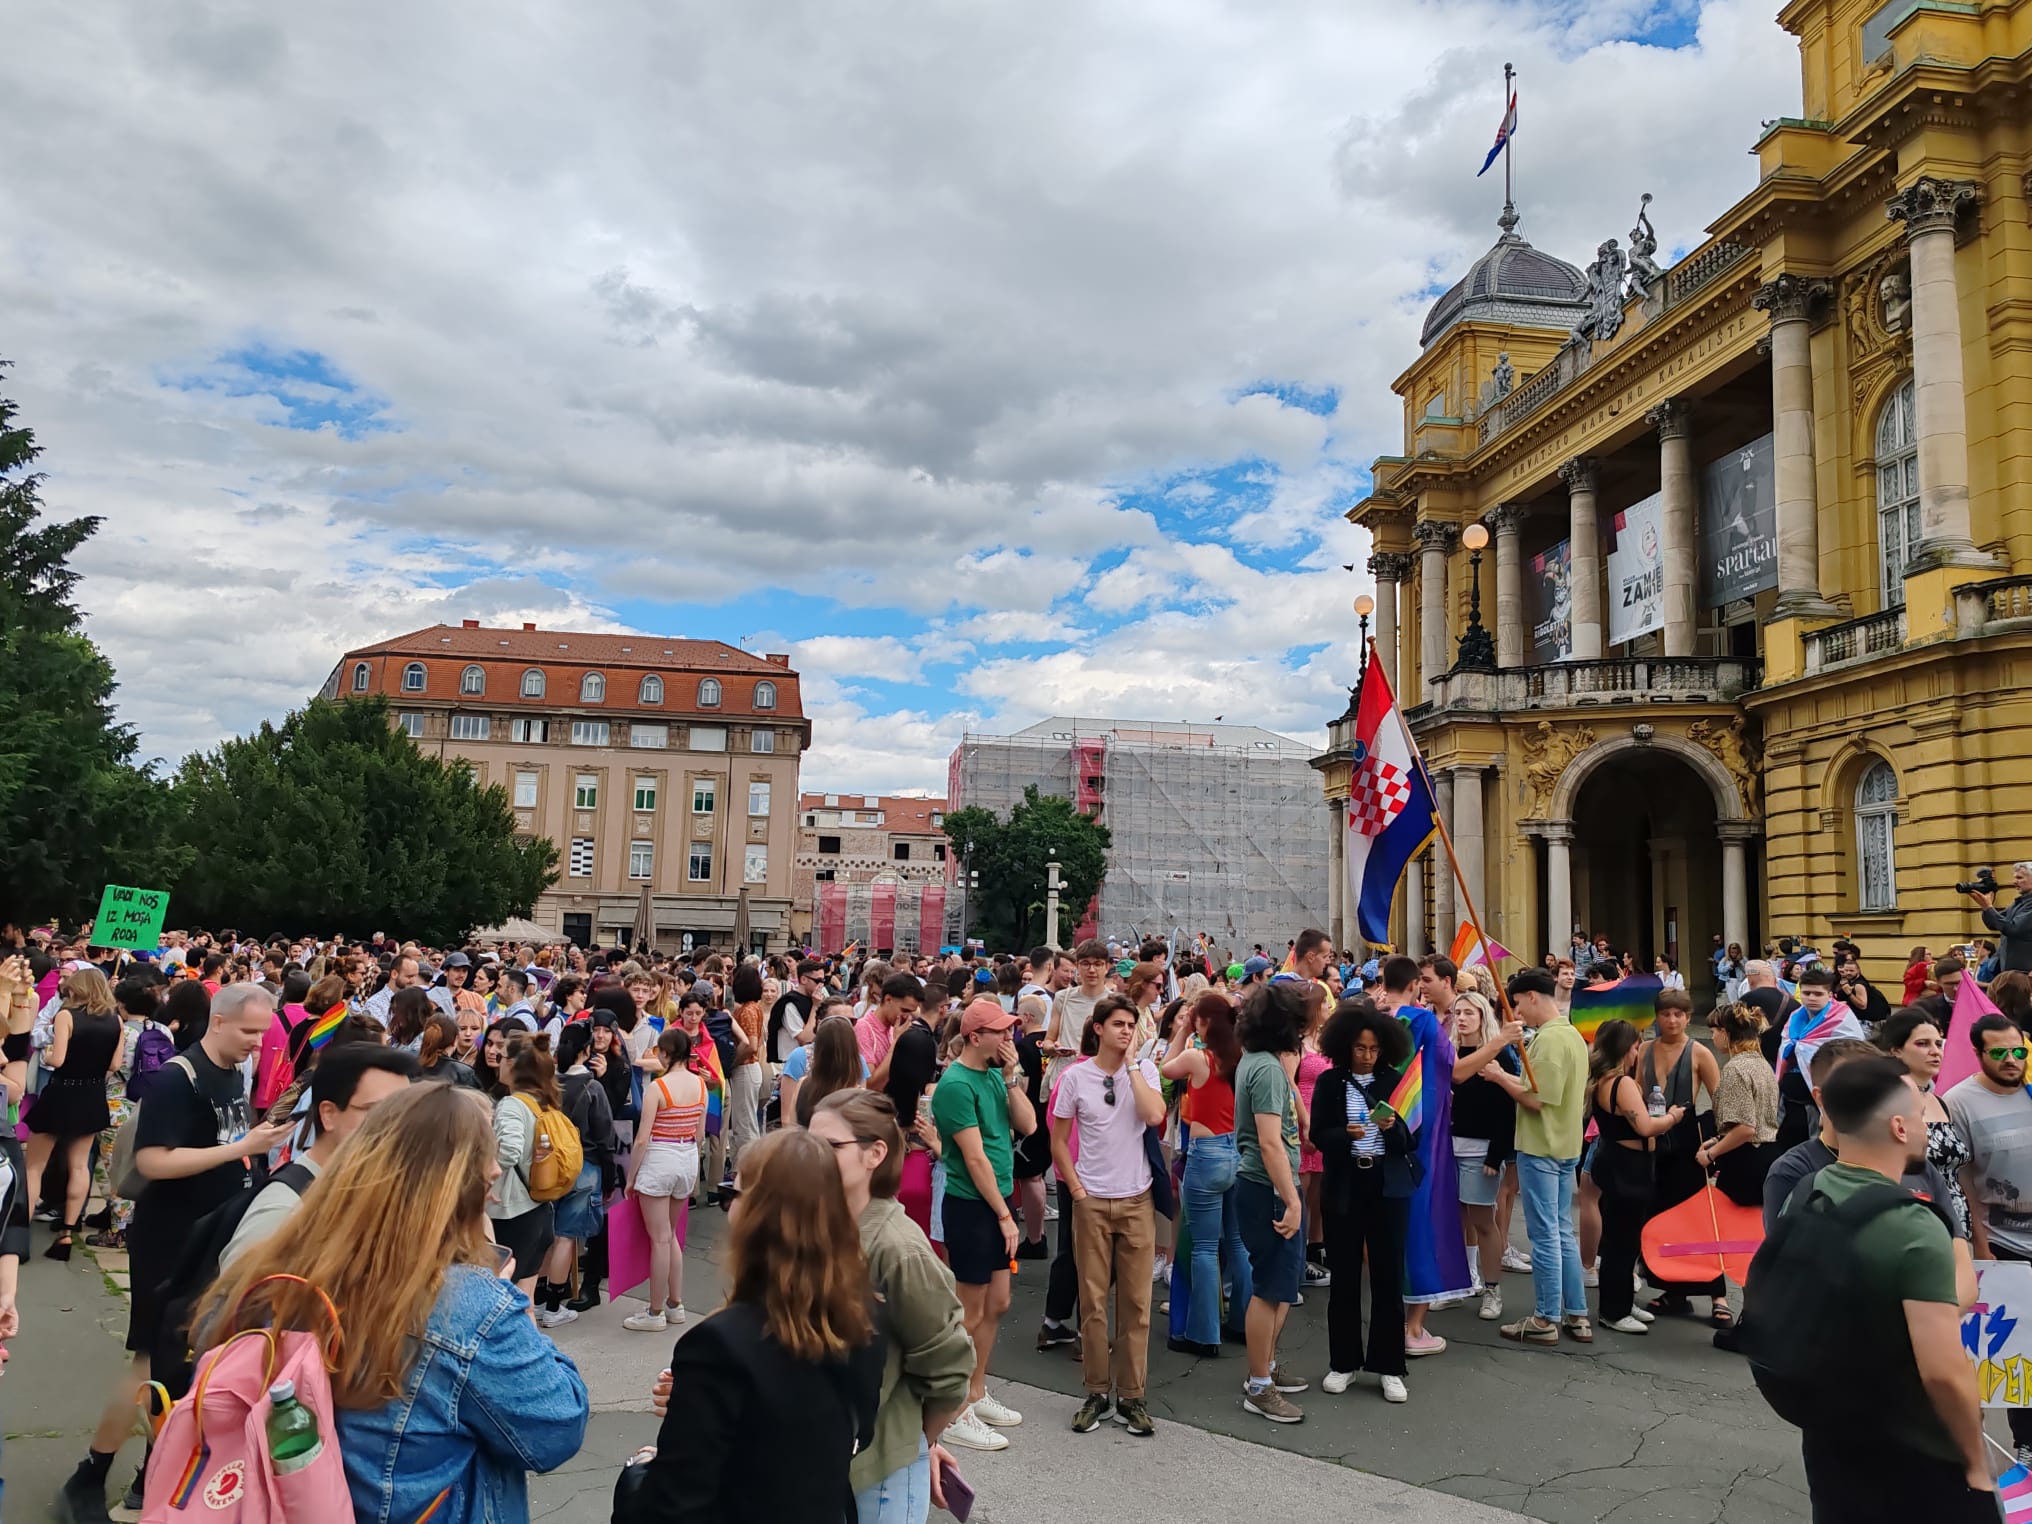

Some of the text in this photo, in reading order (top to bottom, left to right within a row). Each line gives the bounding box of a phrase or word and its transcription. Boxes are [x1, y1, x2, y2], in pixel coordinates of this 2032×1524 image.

[1512, 316, 1746, 480] HRVATSKO NARODNO KAZALIŠTE
[139, 894, 159, 910] NOS
[106, 910, 117, 923] IZ
[111, 928, 137, 942] RODA
